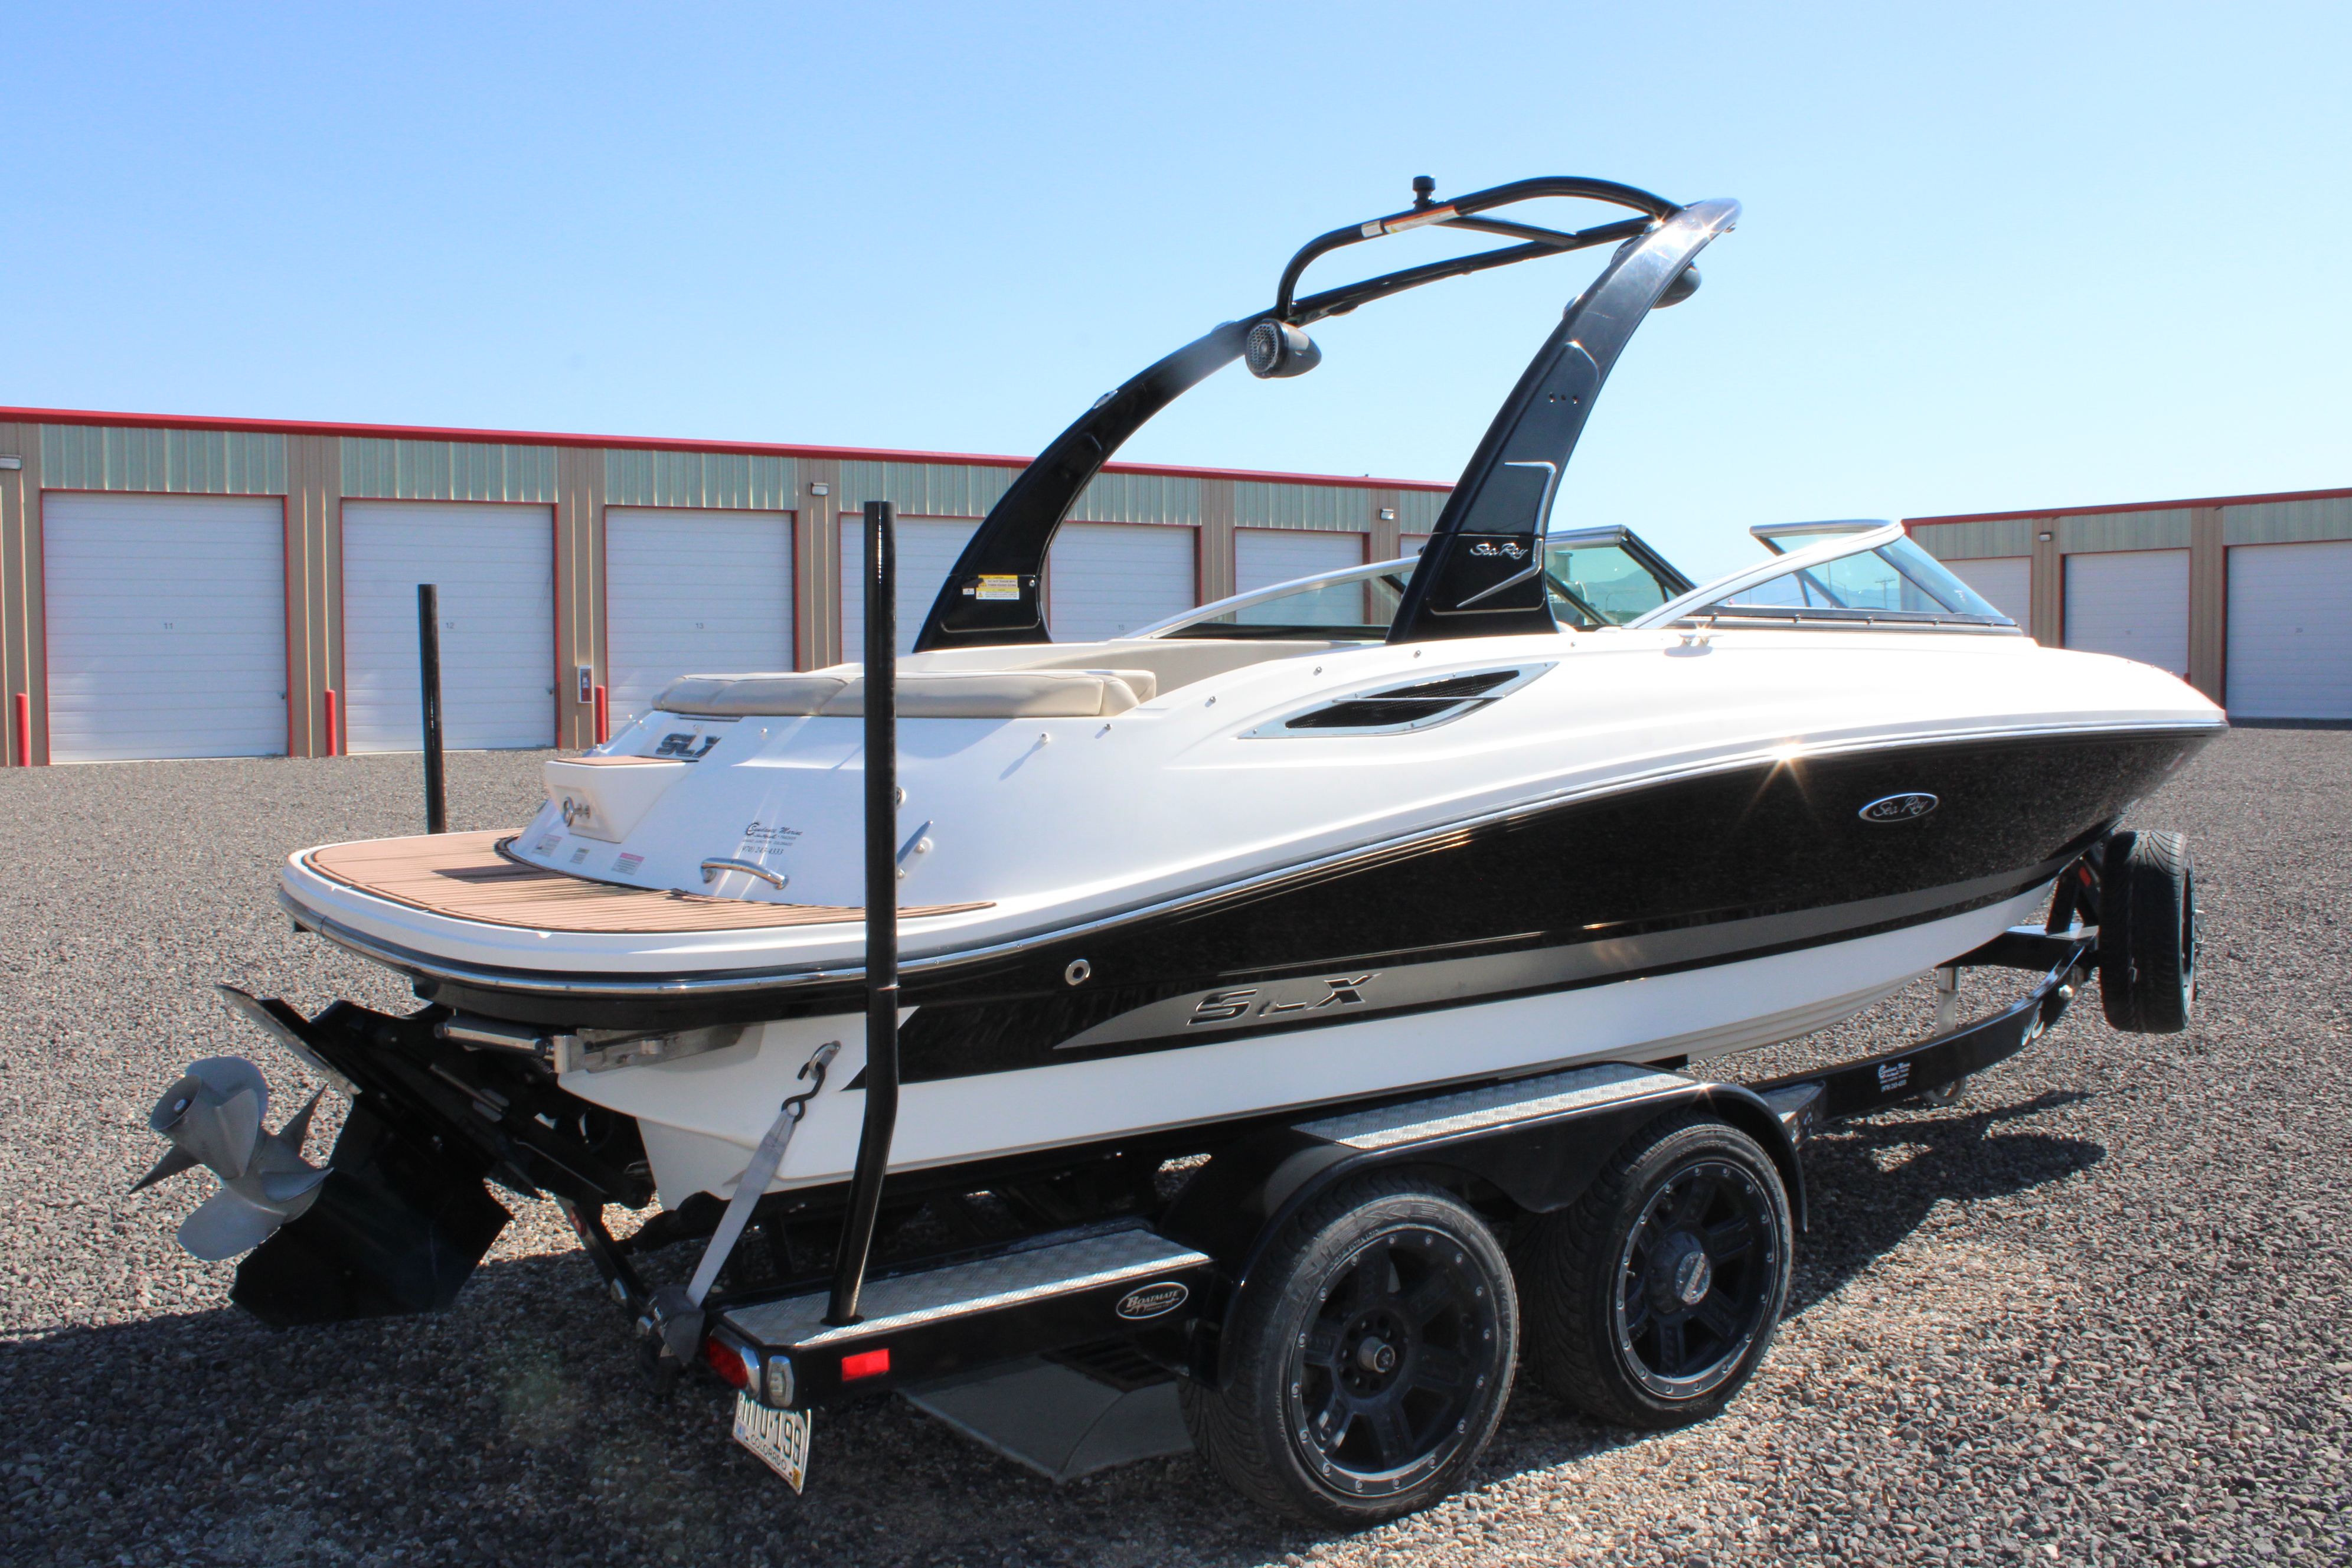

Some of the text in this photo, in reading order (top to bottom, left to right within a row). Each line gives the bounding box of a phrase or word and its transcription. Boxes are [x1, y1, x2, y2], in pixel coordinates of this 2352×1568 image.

[1469, 542, 1529, 560] Sea Ray
[1873, 795, 1929, 816] Sea Ray
[1126, 1289, 1180, 1308] BOATMATE
[750, 1433, 788, 1471] COLORADO
